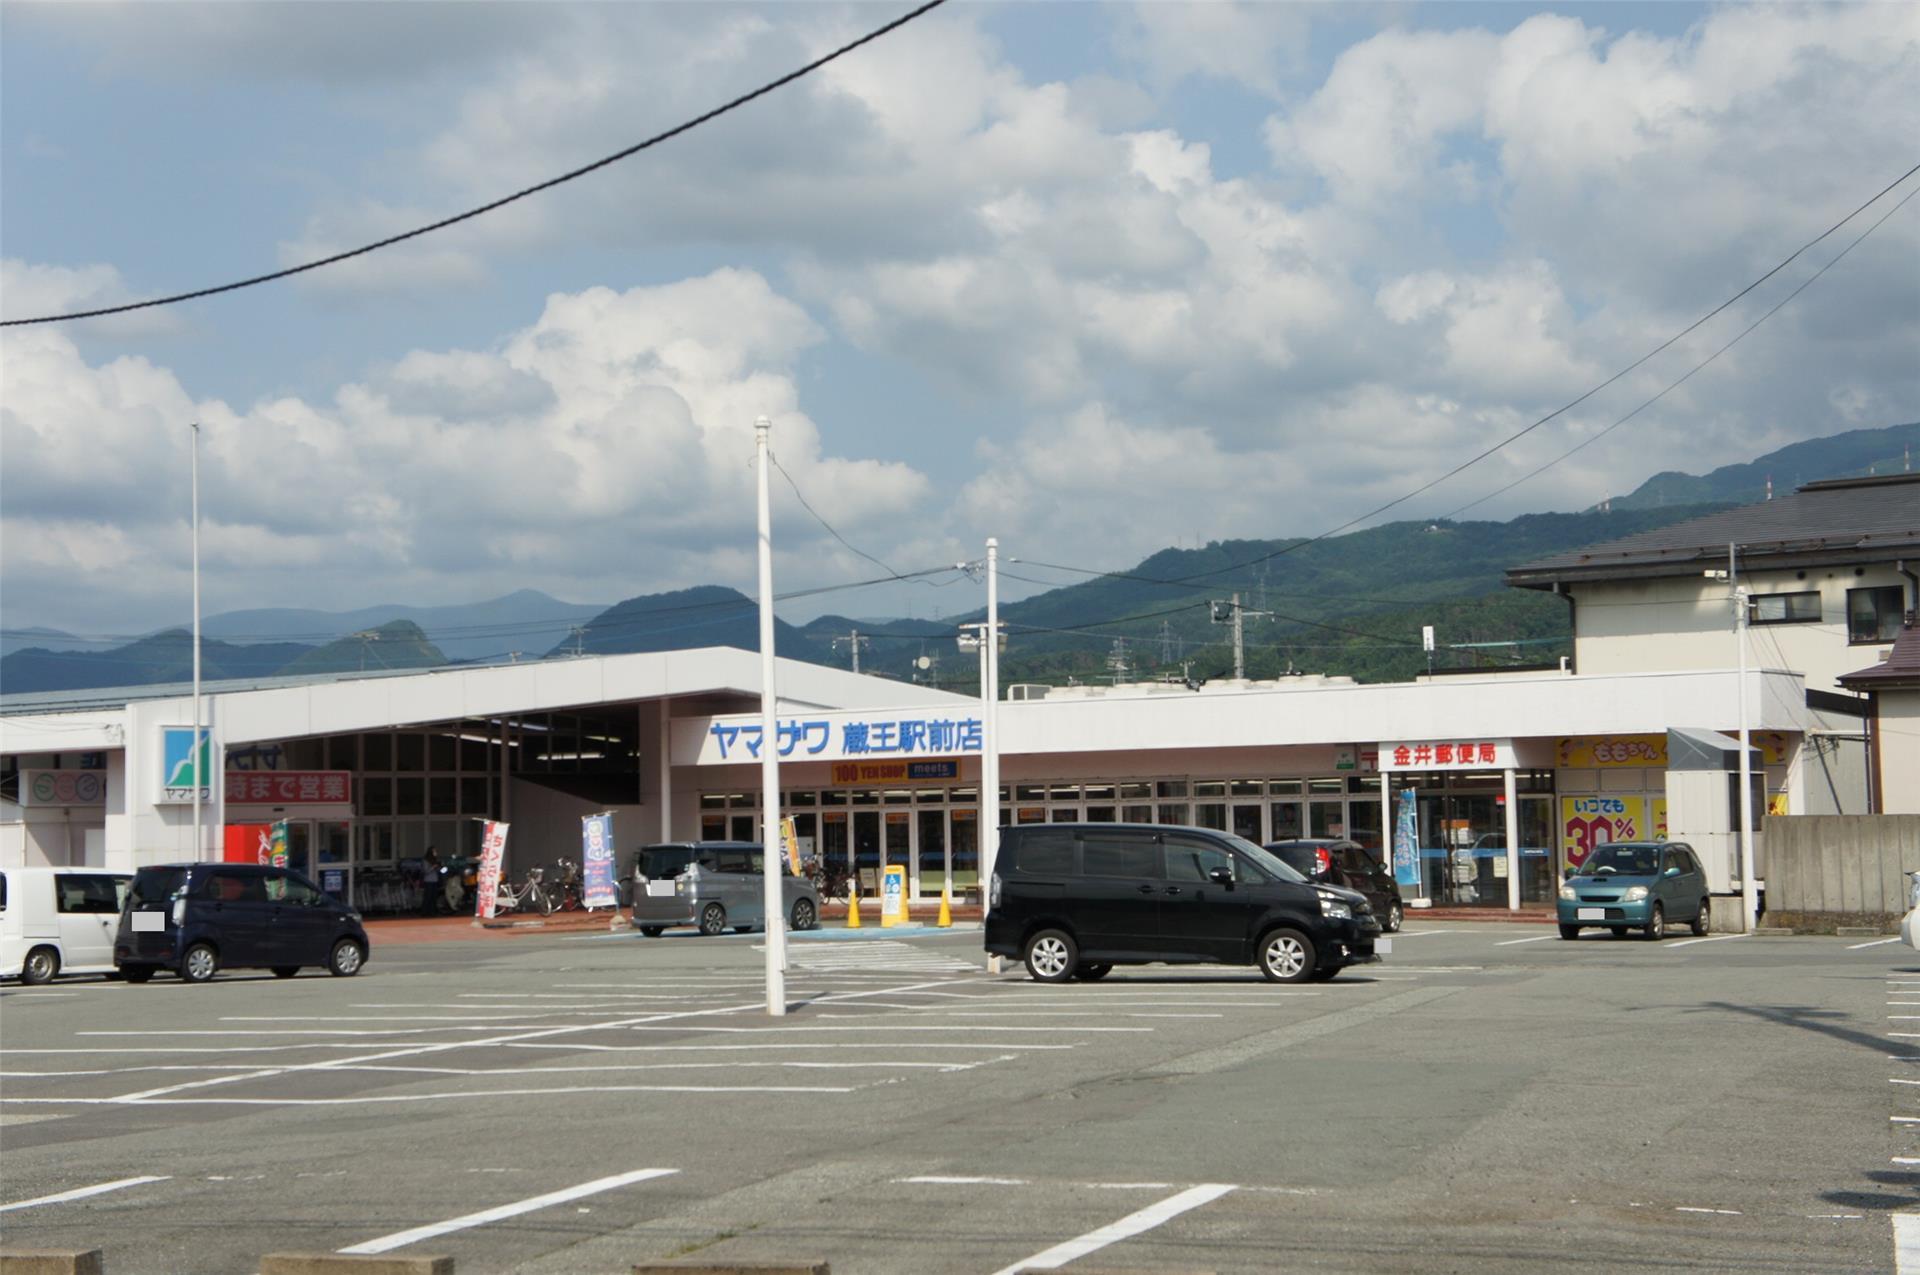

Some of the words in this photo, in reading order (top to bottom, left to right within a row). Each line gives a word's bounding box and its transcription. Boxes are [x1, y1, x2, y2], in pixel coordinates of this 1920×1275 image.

[711, 720, 829, 758] ヤマサワ
[842, 717, 983, 755] 蔵王駅前店
[1393, 742, 1497, 767] 金井郵便局
[835, 763, 858, 782] 100
[860, 765, 880, 780] YEN
[880, 764, 906, 779] SHOP
[913, 760, 949, 774] meets
[1574, 799, 1625, 814] いつでも
[1566, 815, 1636, 869] 30%
